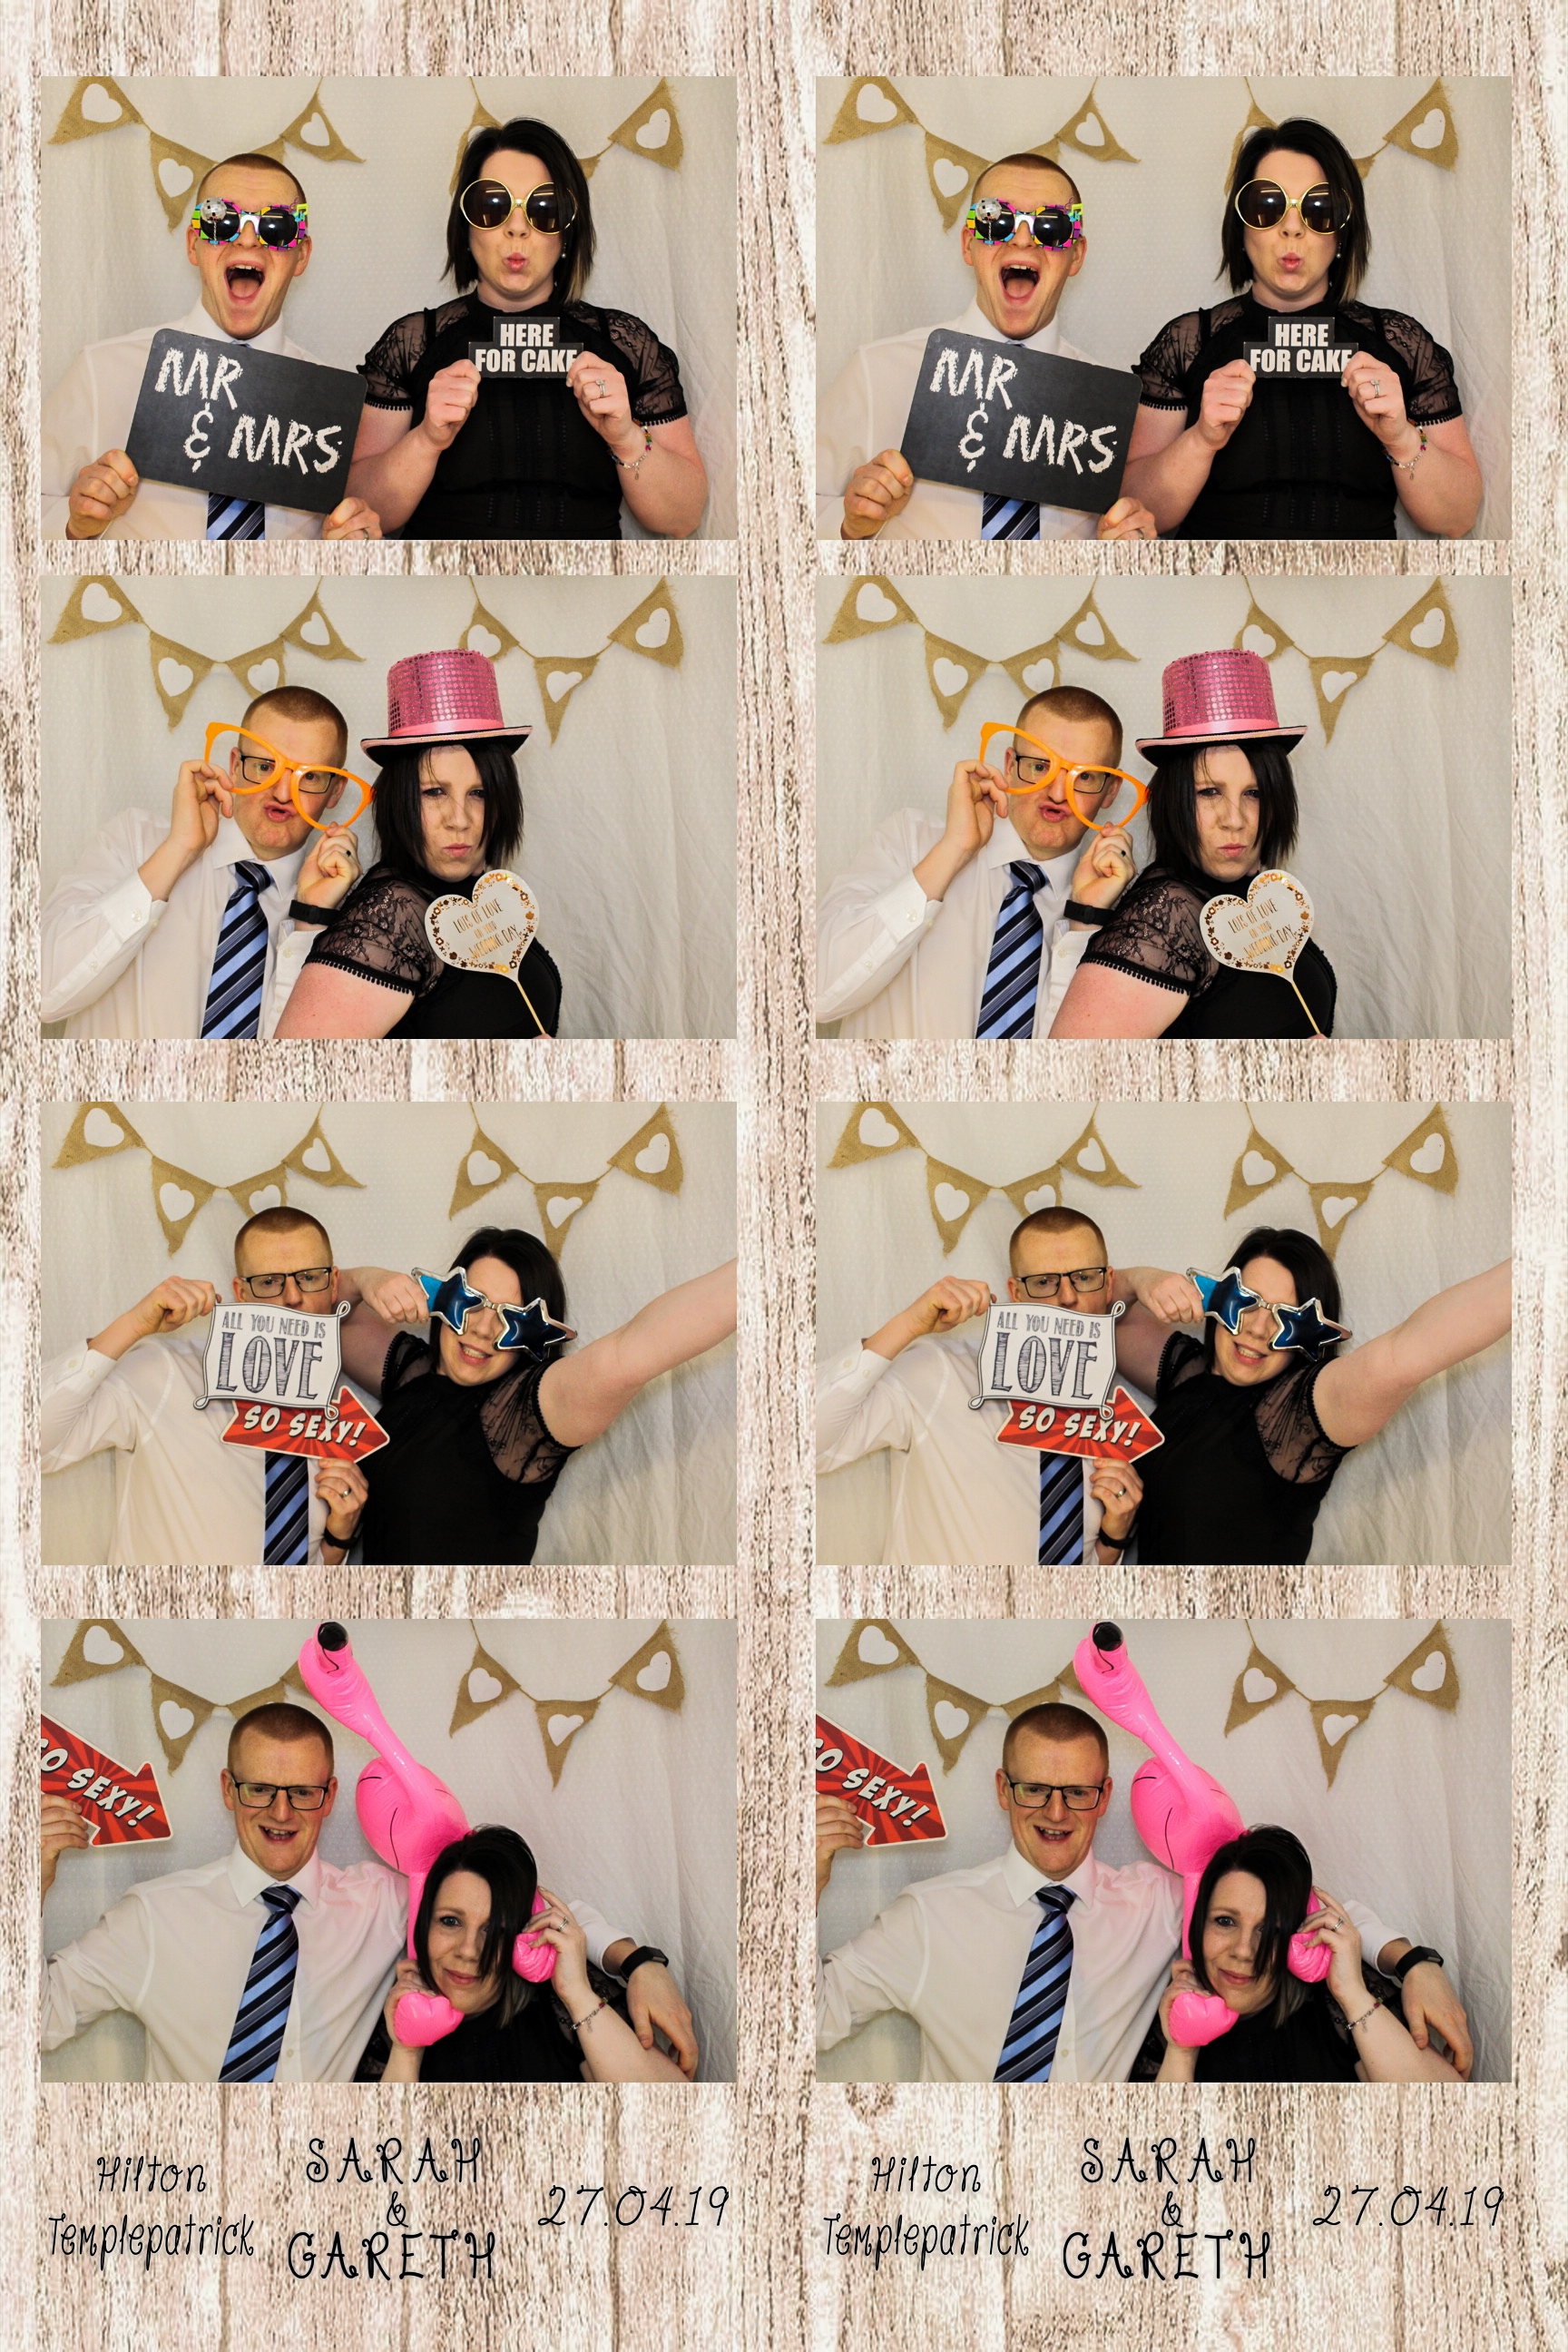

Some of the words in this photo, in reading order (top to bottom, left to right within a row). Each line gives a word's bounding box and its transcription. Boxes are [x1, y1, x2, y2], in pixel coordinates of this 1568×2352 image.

[500, 323, 554, 348] HERE
[1275, 323, 1329, 348] HERE
[155, 348, 243, 409] MR
[475, 348, 516, 373] FOR
[930, 348, 1018, 409] MR
[1250, 348, 1291, 373] FOR
[183, 402, 214, 473] &
[228, 414, 342, 475] MRS
[958, 402, 989, 473] &
[1003, 414, 1117, 475] MRS
[453, 914, 474, 934] LOTS
[472, 909, 483, 924] OF
[481, 898, 503, 918] LOVE
[1228, 914, 1249, 934] LOTS
[1247, 909, 1258, 924] OF
[1256, 898, 1278, 918] LOVE
[468, 934, 504, 959] WEDDING
[501, 924, 521, 943] DAY
[1243, 934, 1279, 959] WEDDING
[1276, 924, 1296, 943] DAY
[221, 1311, 243, 1330] ALL
[250, 1313, 274, 1333] YOU
[279, 1317, 309, 1337] NEED
[314, 1321, 326, 1339] IS
[996, 1311, 1018, 1330] ALL
[1025, 1313, 1049, 1333] YOU
[1054, 1317, 1084, 1337] NEED
[1089, 1321, 1101, 1339] IS
[216, 1332, 323, 1400] LOVE
[991, 1332, 1098, 1400] LOVE
[243, 1405, 281, 1434] SO
[288, 1412, 367, 1447] SEXY!
[1018, 1405, 1056, 1434] SO
[1063, 1412, 1142, 1447] SEXY!
[67, 1768, 155, 1828] SEXY!
[842, 1768, 930, 1828] SEXY!
